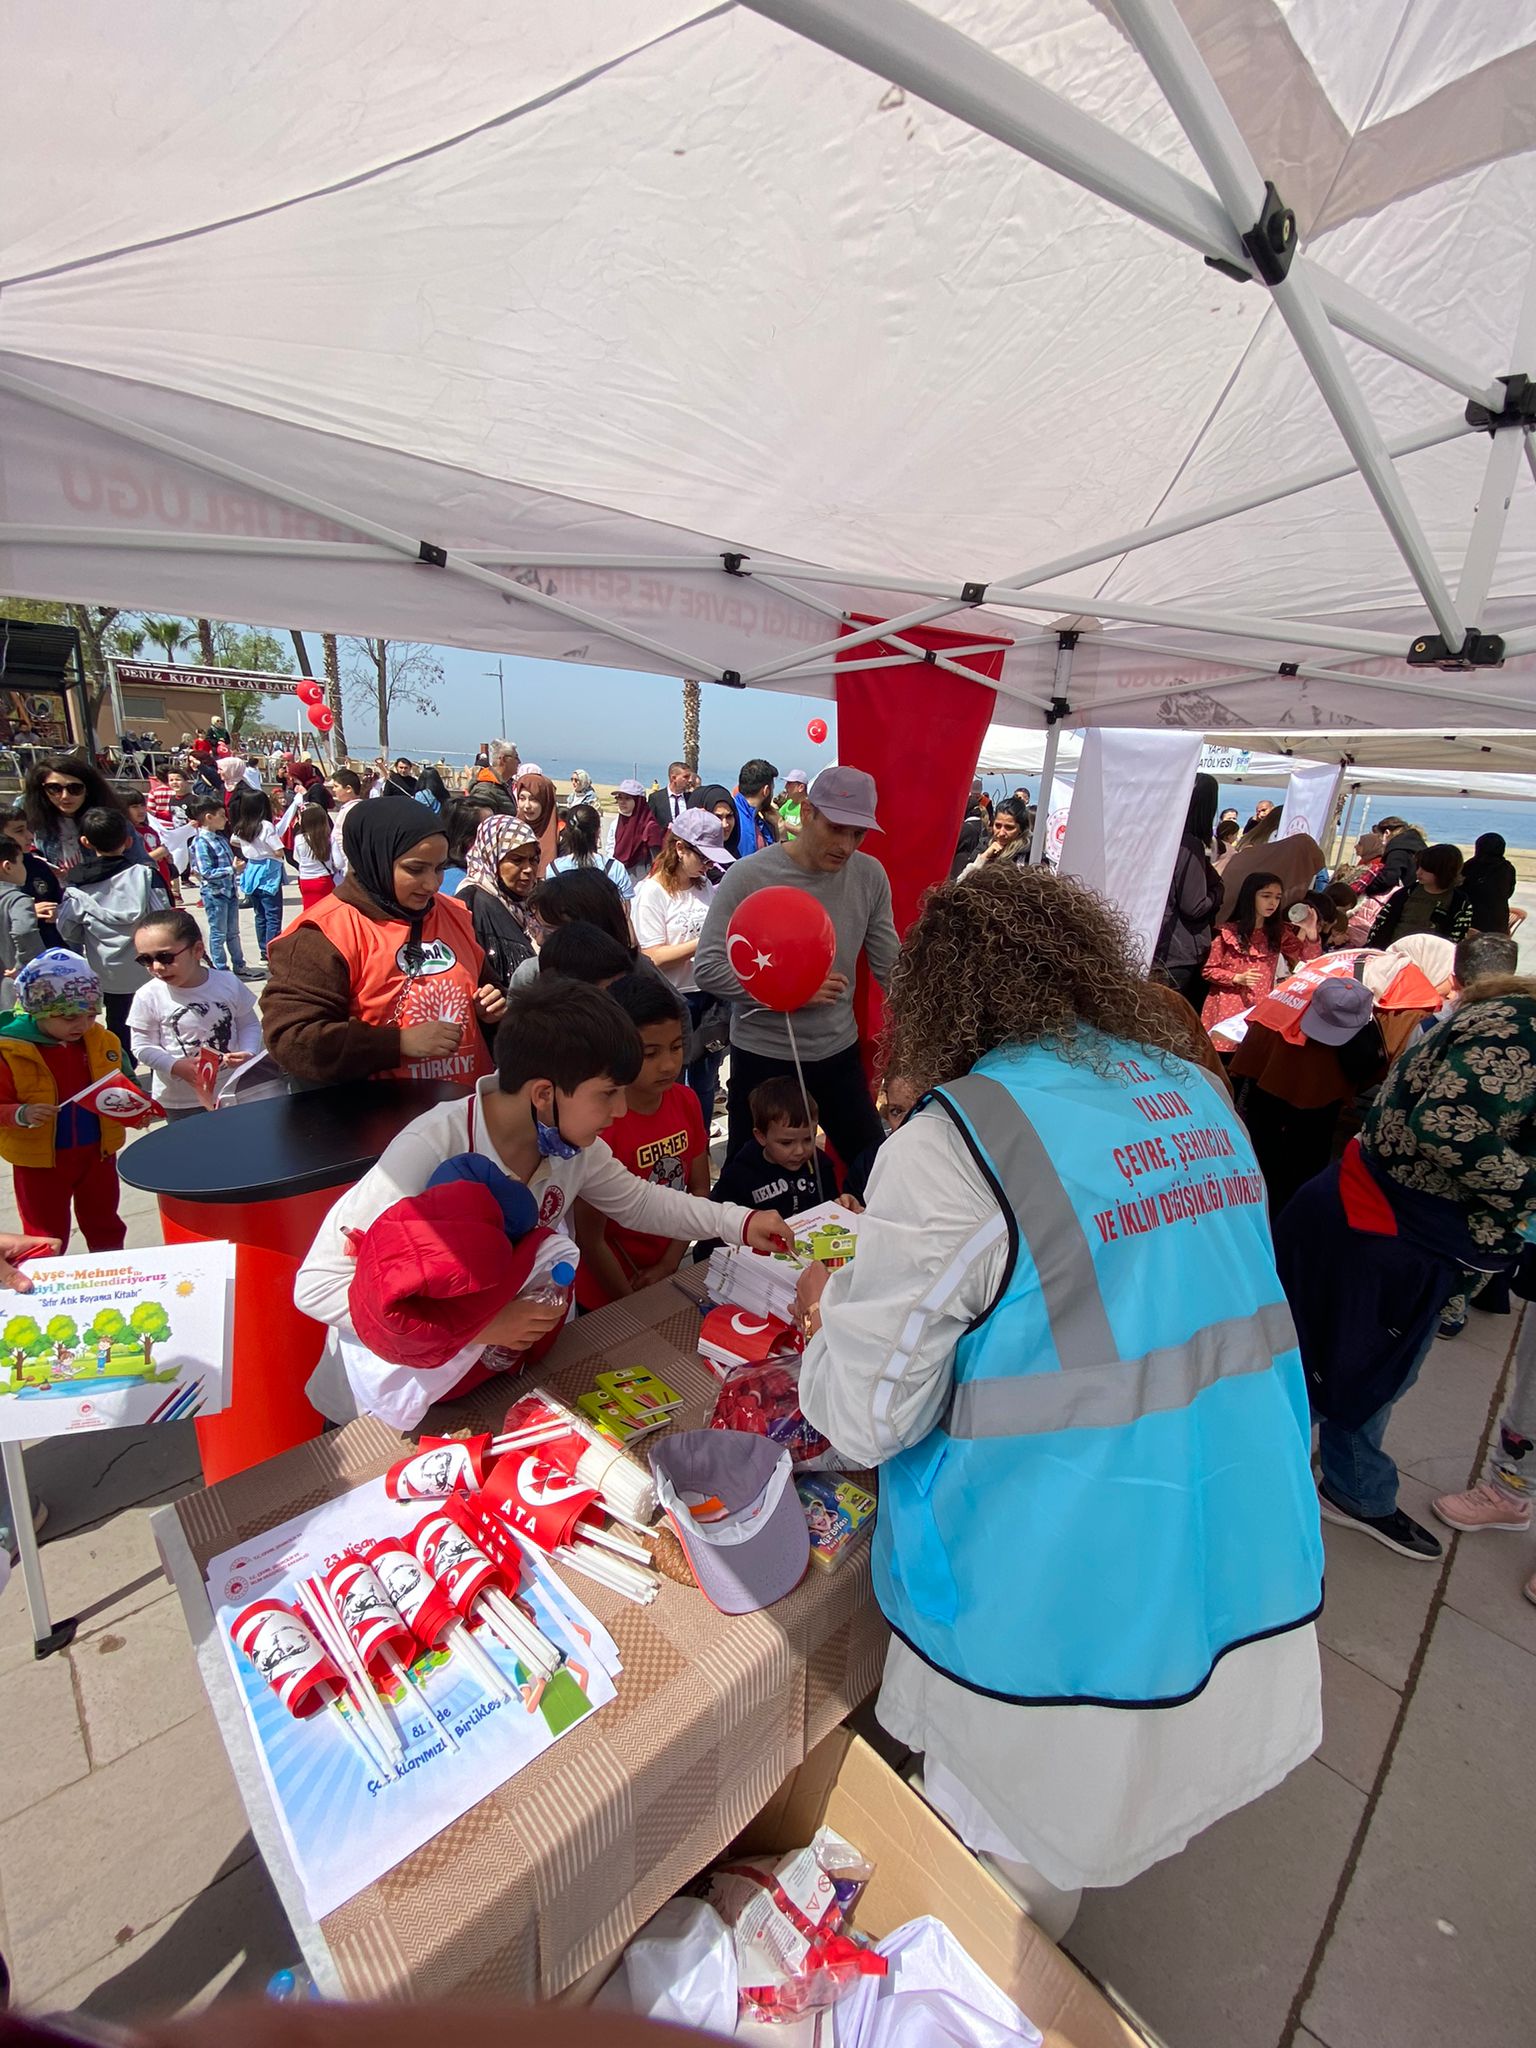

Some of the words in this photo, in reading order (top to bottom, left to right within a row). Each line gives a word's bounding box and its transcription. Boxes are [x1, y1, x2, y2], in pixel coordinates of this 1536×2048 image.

[1117, 1060, 1156, 1084] T.C.
[1132, 1091, 1193, 1122] YALOVA
[639, 1131, 688, 1166] GAMER
[1112, 1136, 1177, 1187] ÇEVRE,
[751, 1178, 789, 1204] HELLO
[1094, 1210, 1118, 1243] VE
[1115, 1191, 1160, 1236] İKLİM
[32, 1270, 65, 1283] Ayşe
[74, 1266, 133, 1280] Mehmet
[56, 1273, 167, 1291] Renklendiriyoruz
[80, 1293, 112, 1304] Boyama
[500, 1498, 537, 1534] ATA
[323, 1552, 341, 1569] 23
[412, 1724, 427, 1738] 81
